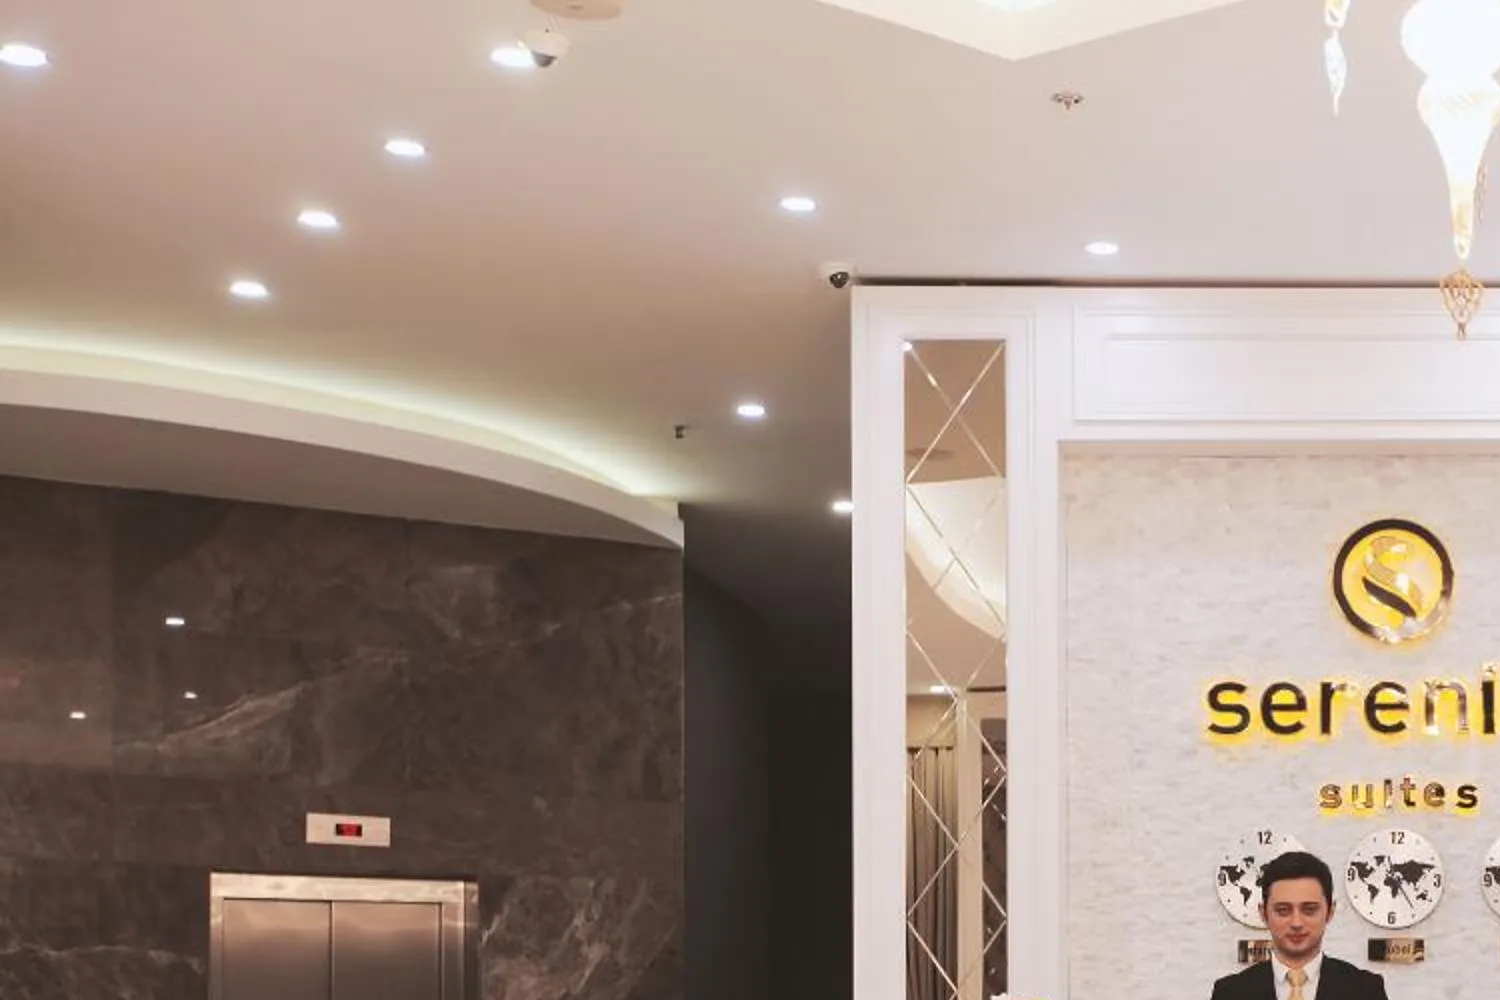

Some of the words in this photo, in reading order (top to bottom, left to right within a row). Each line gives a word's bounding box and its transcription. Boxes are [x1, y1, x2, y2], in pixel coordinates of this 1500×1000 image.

[1319, 777, 1478, 809] suites
[1257, 831, 1273, 845] 12
[1390, 831, 1405, 845] 12
[1217, 872, 1227, 886] 9
[1347, 867, 1355, 882] 9
[1433, 873, 1441, 888] 3
[1483, 873, 1493, 887] 9
[1387, 911, 1396, 925] 6
